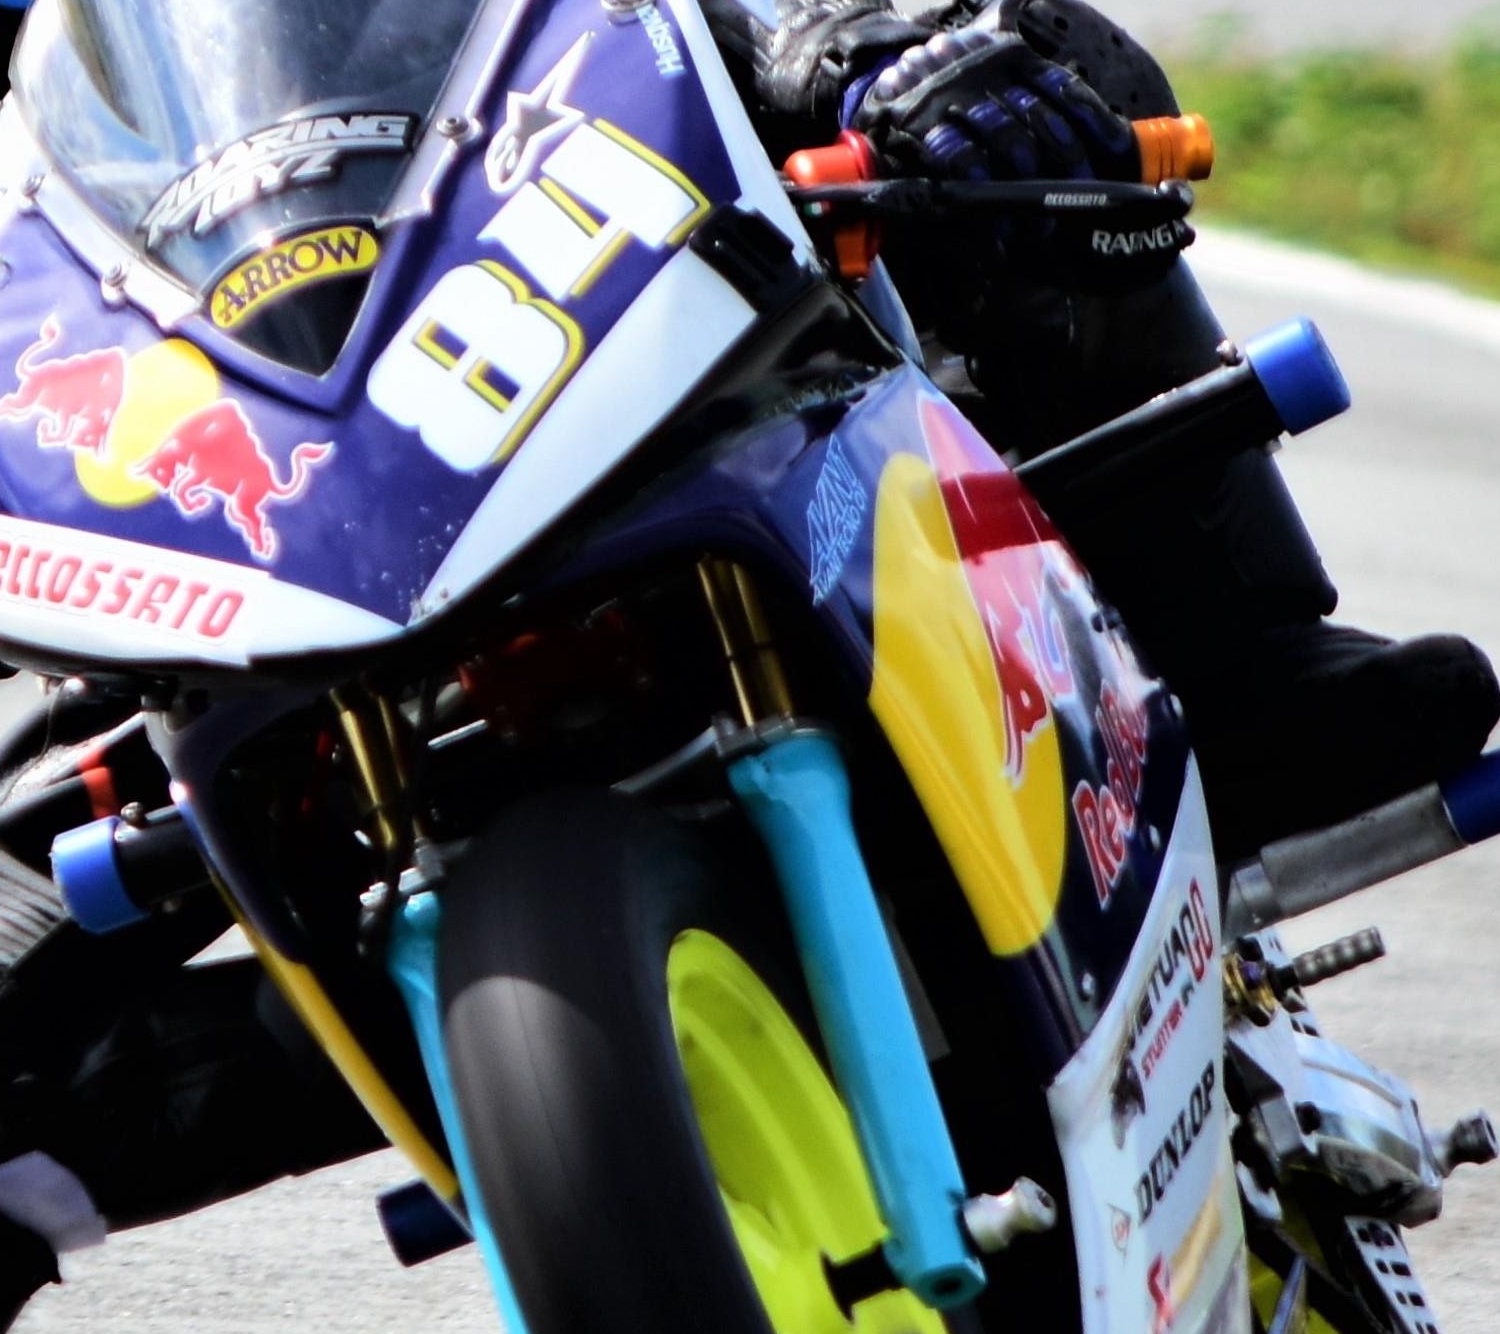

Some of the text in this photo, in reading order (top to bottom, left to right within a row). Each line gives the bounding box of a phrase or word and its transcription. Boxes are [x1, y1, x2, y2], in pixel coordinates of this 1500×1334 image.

[217, 229, 364, 323] ARROW
[367, 117, 710, 470] 84
[1136, 1059, 1215, 1229] DUNLOP
